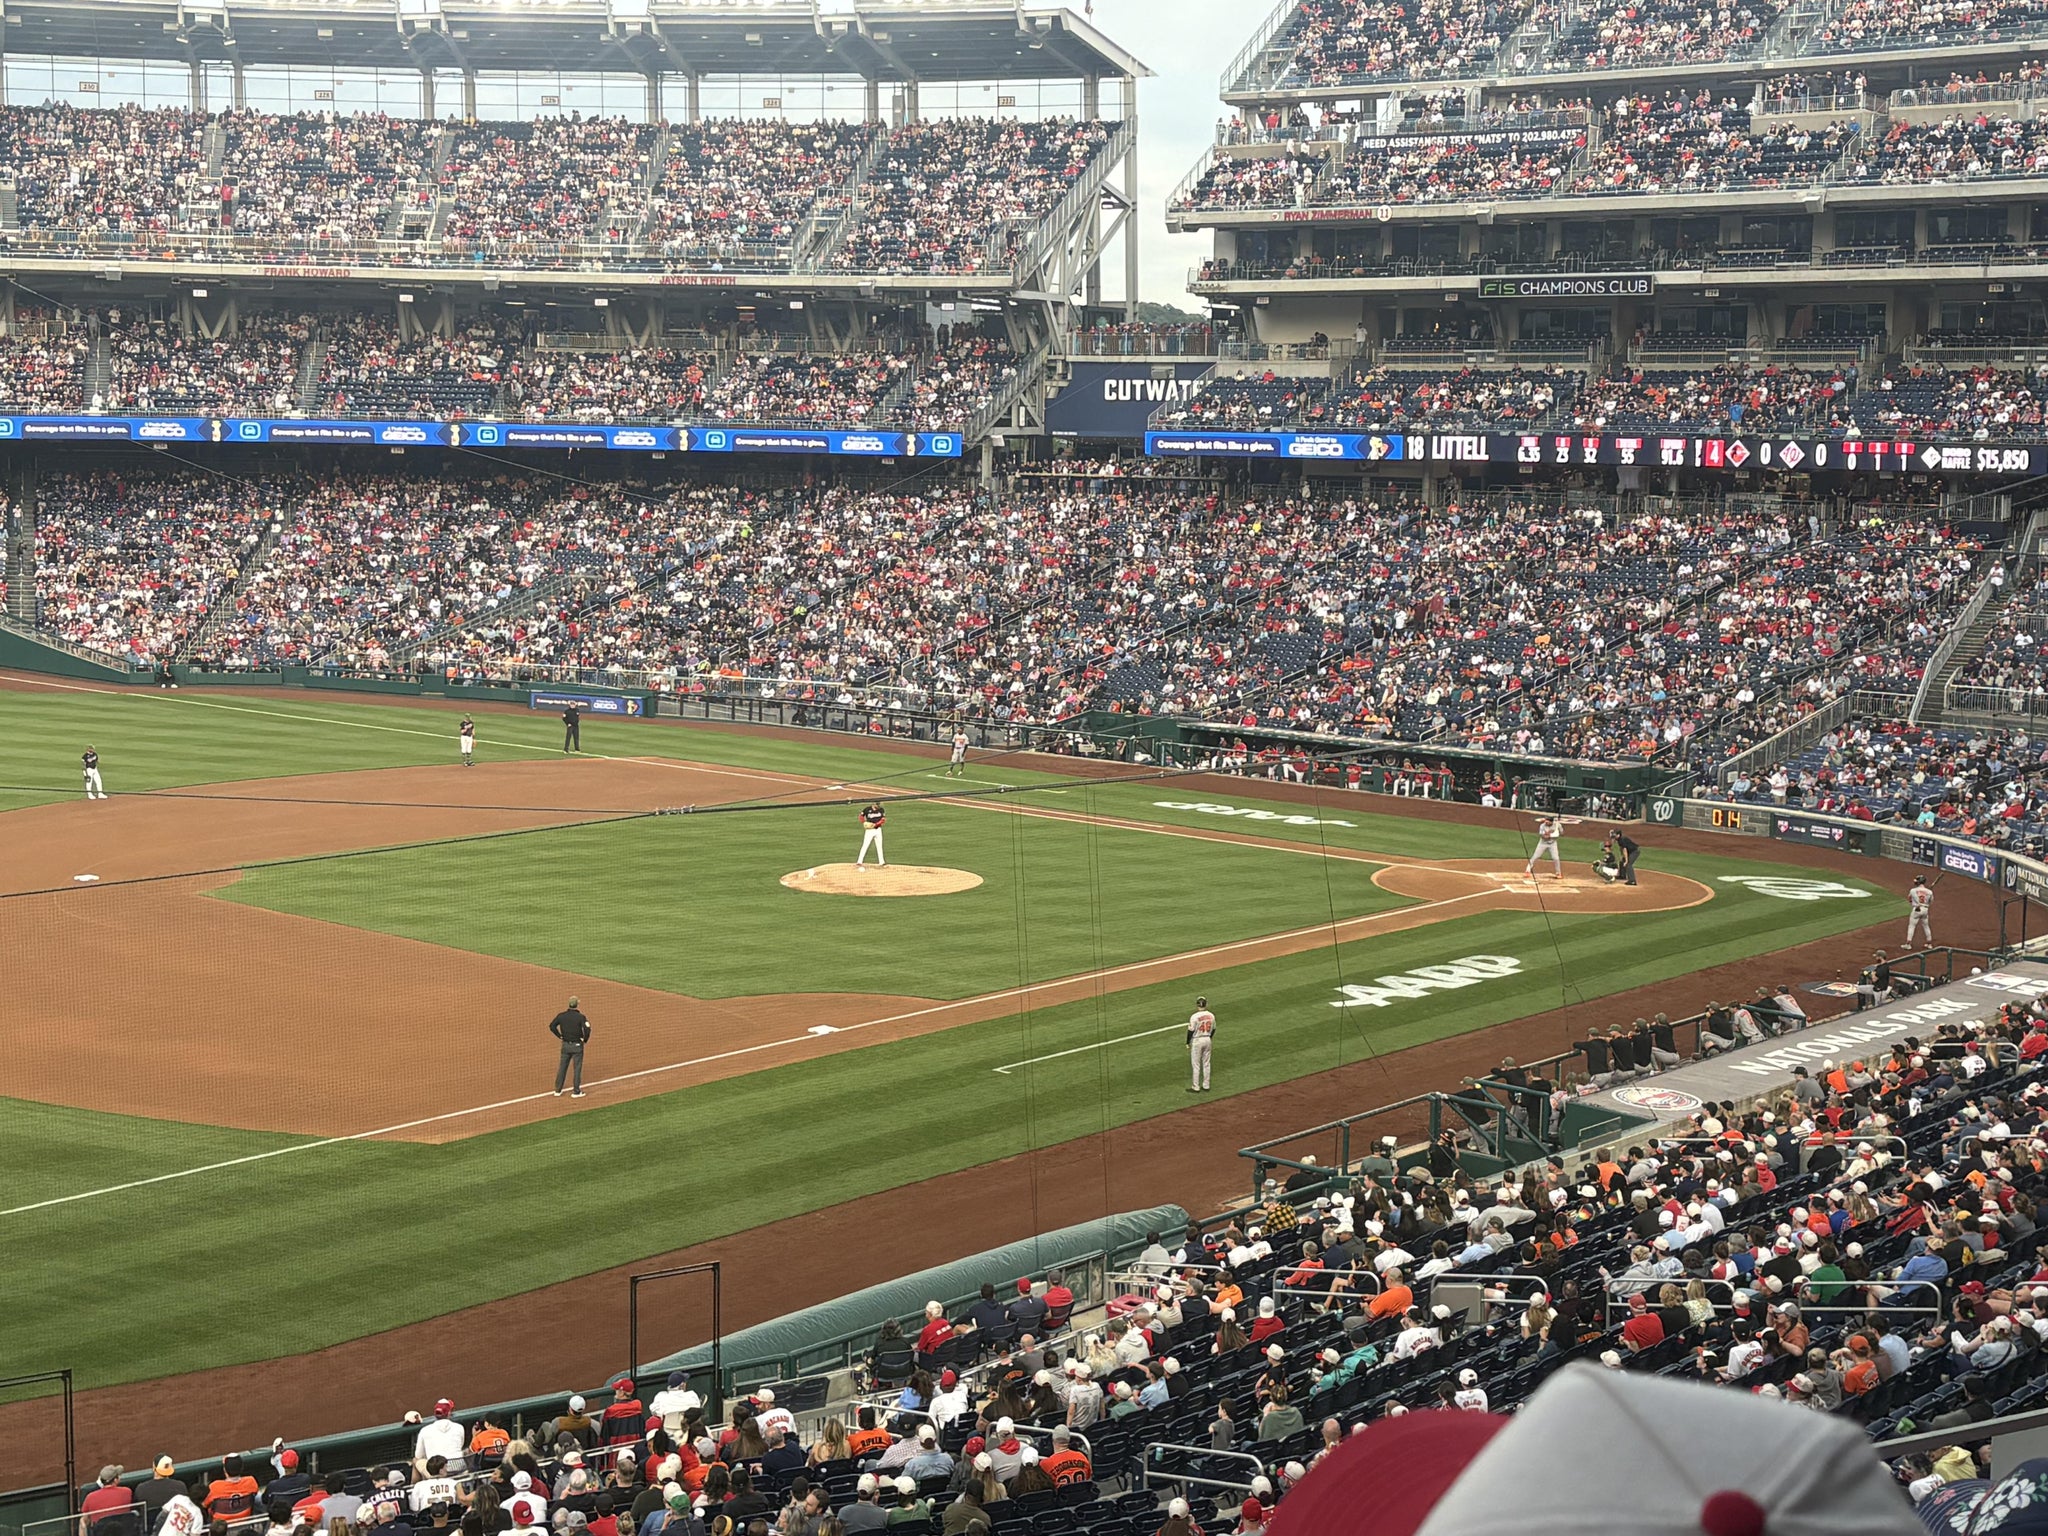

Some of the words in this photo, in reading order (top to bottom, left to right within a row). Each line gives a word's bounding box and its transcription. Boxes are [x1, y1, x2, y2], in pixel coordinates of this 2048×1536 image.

[1362, 138, 1387, 149] NEED
[1508, 132, 1520, 143] TO
[1284, 211, 1308, 221] RYAN
[1311, 208, 1372, 221] ZIMMERMAN
[264, 267, 300, 277] FRANK
[303, 268, 351, 278] HOWARD
[660, 275, 697, 285] JAYSON
[701, 276, 736, 285] WERTH
[1520, 280, 1606, 294] CHAMPIONS
[1609, 280, 1648, 293] CLUB
[1104, 379, 1213, 401] CUTWATE
[139, 426, 186, 437] GEICO
[1157, 440, 1195, 451] Coverage
[1289, 443, 1343, 456] GEICO
[1407, 436, 1424, 460] 18
[1432, 436, 1489, 460] LITTELL
[1760, 442, 1772, 466] 0
[1620, 449, 1635, 465] 55
[1661, 449, 1684, 466] 91.6
[1710, 445, 1720, 464] 4
[1815, 443, 1828, 467] 0
[1847, 453, 1857, 471] 0
[1874, 453, 1881, 471] 1
[1901, 454, 1907, 472] 1
[1976, 447, 2030, 473] $15,850
[1941, 458, 1971, 469] RAFFLE
[1945, 854, 1979, 873] GEICO
[2024, 882, 2040, 898] PARK
[1728, 1020, 1908, 1075] NATIONALS
[1886, 997, 1979, 1025] PARK
[430, 1484, 450, 1495] SOTO
